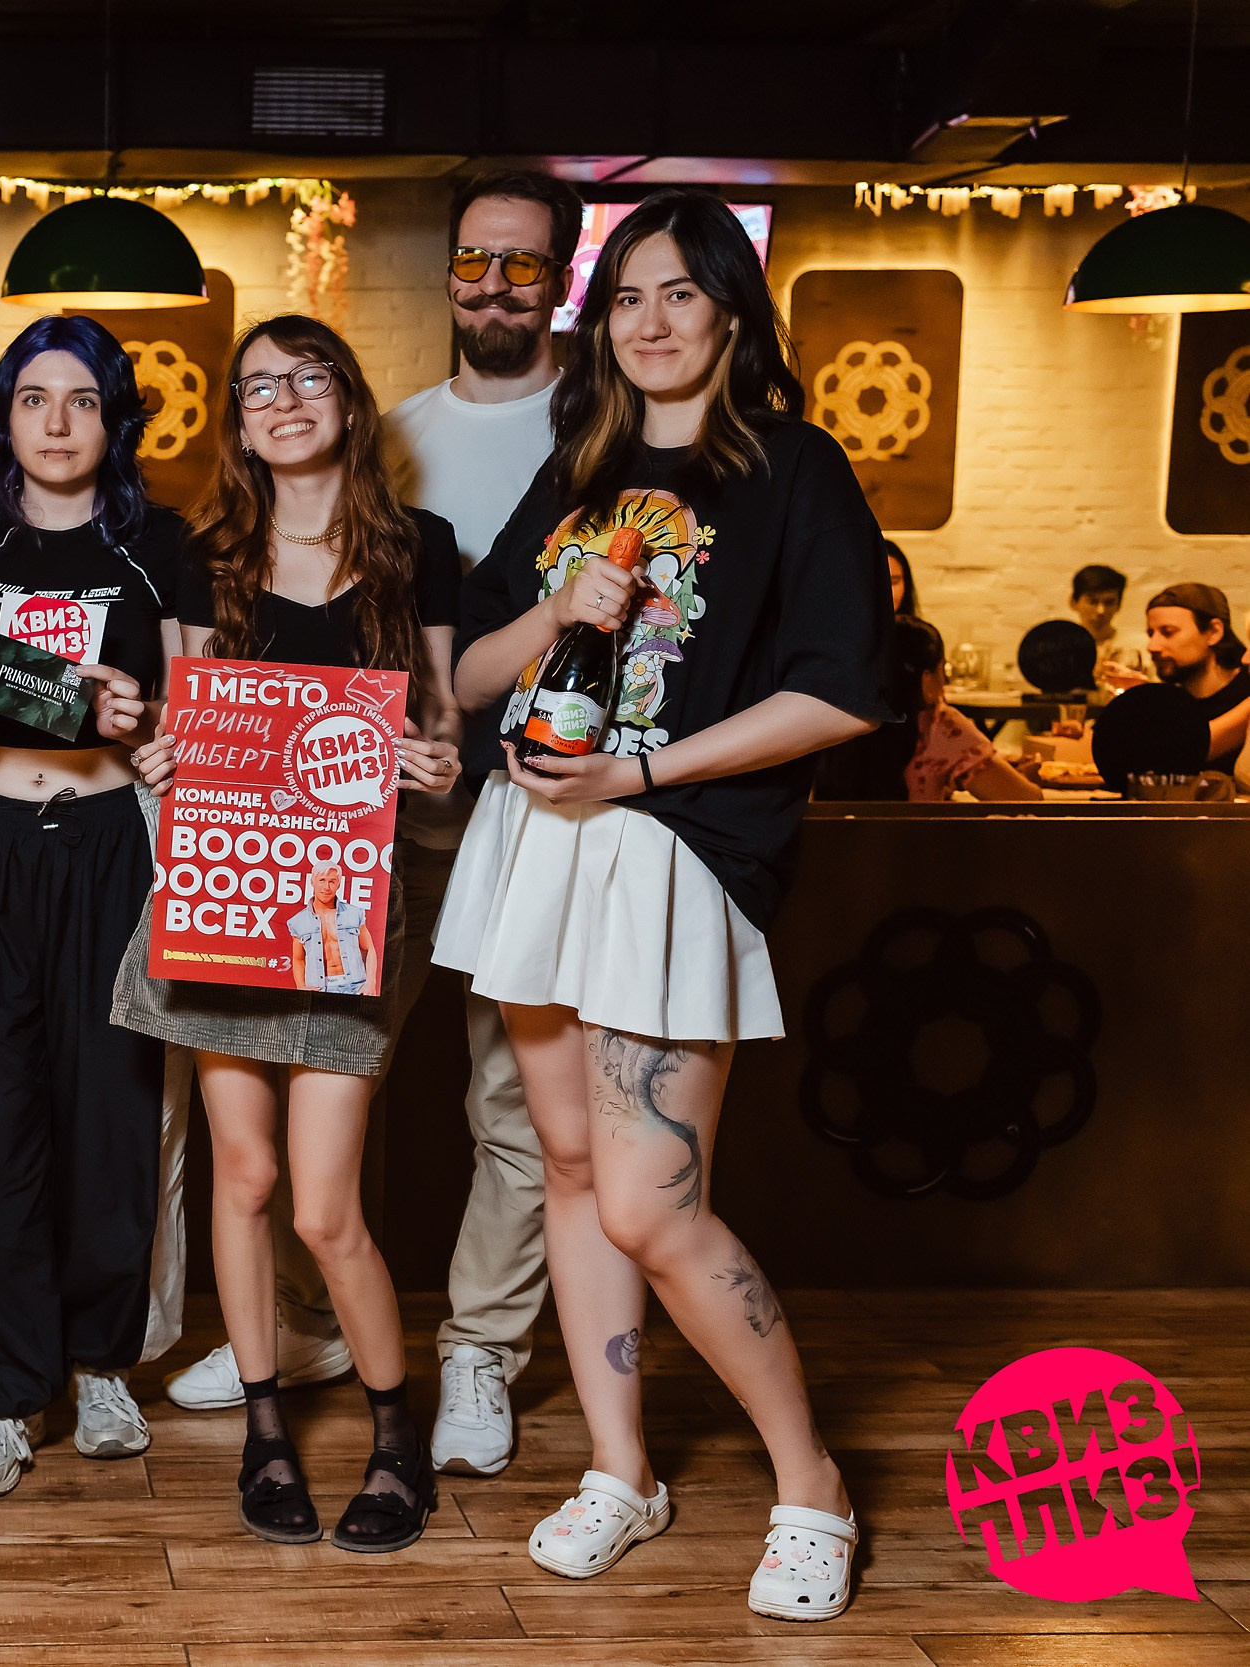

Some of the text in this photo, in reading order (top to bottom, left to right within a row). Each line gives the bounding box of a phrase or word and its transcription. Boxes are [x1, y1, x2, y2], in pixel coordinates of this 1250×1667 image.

[80, 586, 122, 599] LEGEND
[11, 605, 90, 635] КВИЗ,
[15, 630, 90, 654] ЛИЗ!
[186, 674, 328, 709] 1 МЕСТО
[173, 708, 273, 743] ПРИНЦ
[537, 710, 553, 722] SAN
[173, 738, 281, 771] АЛЬБЕРТ
[301, 728, 387, 765] КВИЗ,
[300, 754, 388, 789] ПЛИЗ!
[174, 787, 267, 810] КОМАНДЕ,
[172, 806, 350, 833] КОТОРАЯ РАЗНЕСЛА
[165, 899, 278, 940] ВСЕХ
